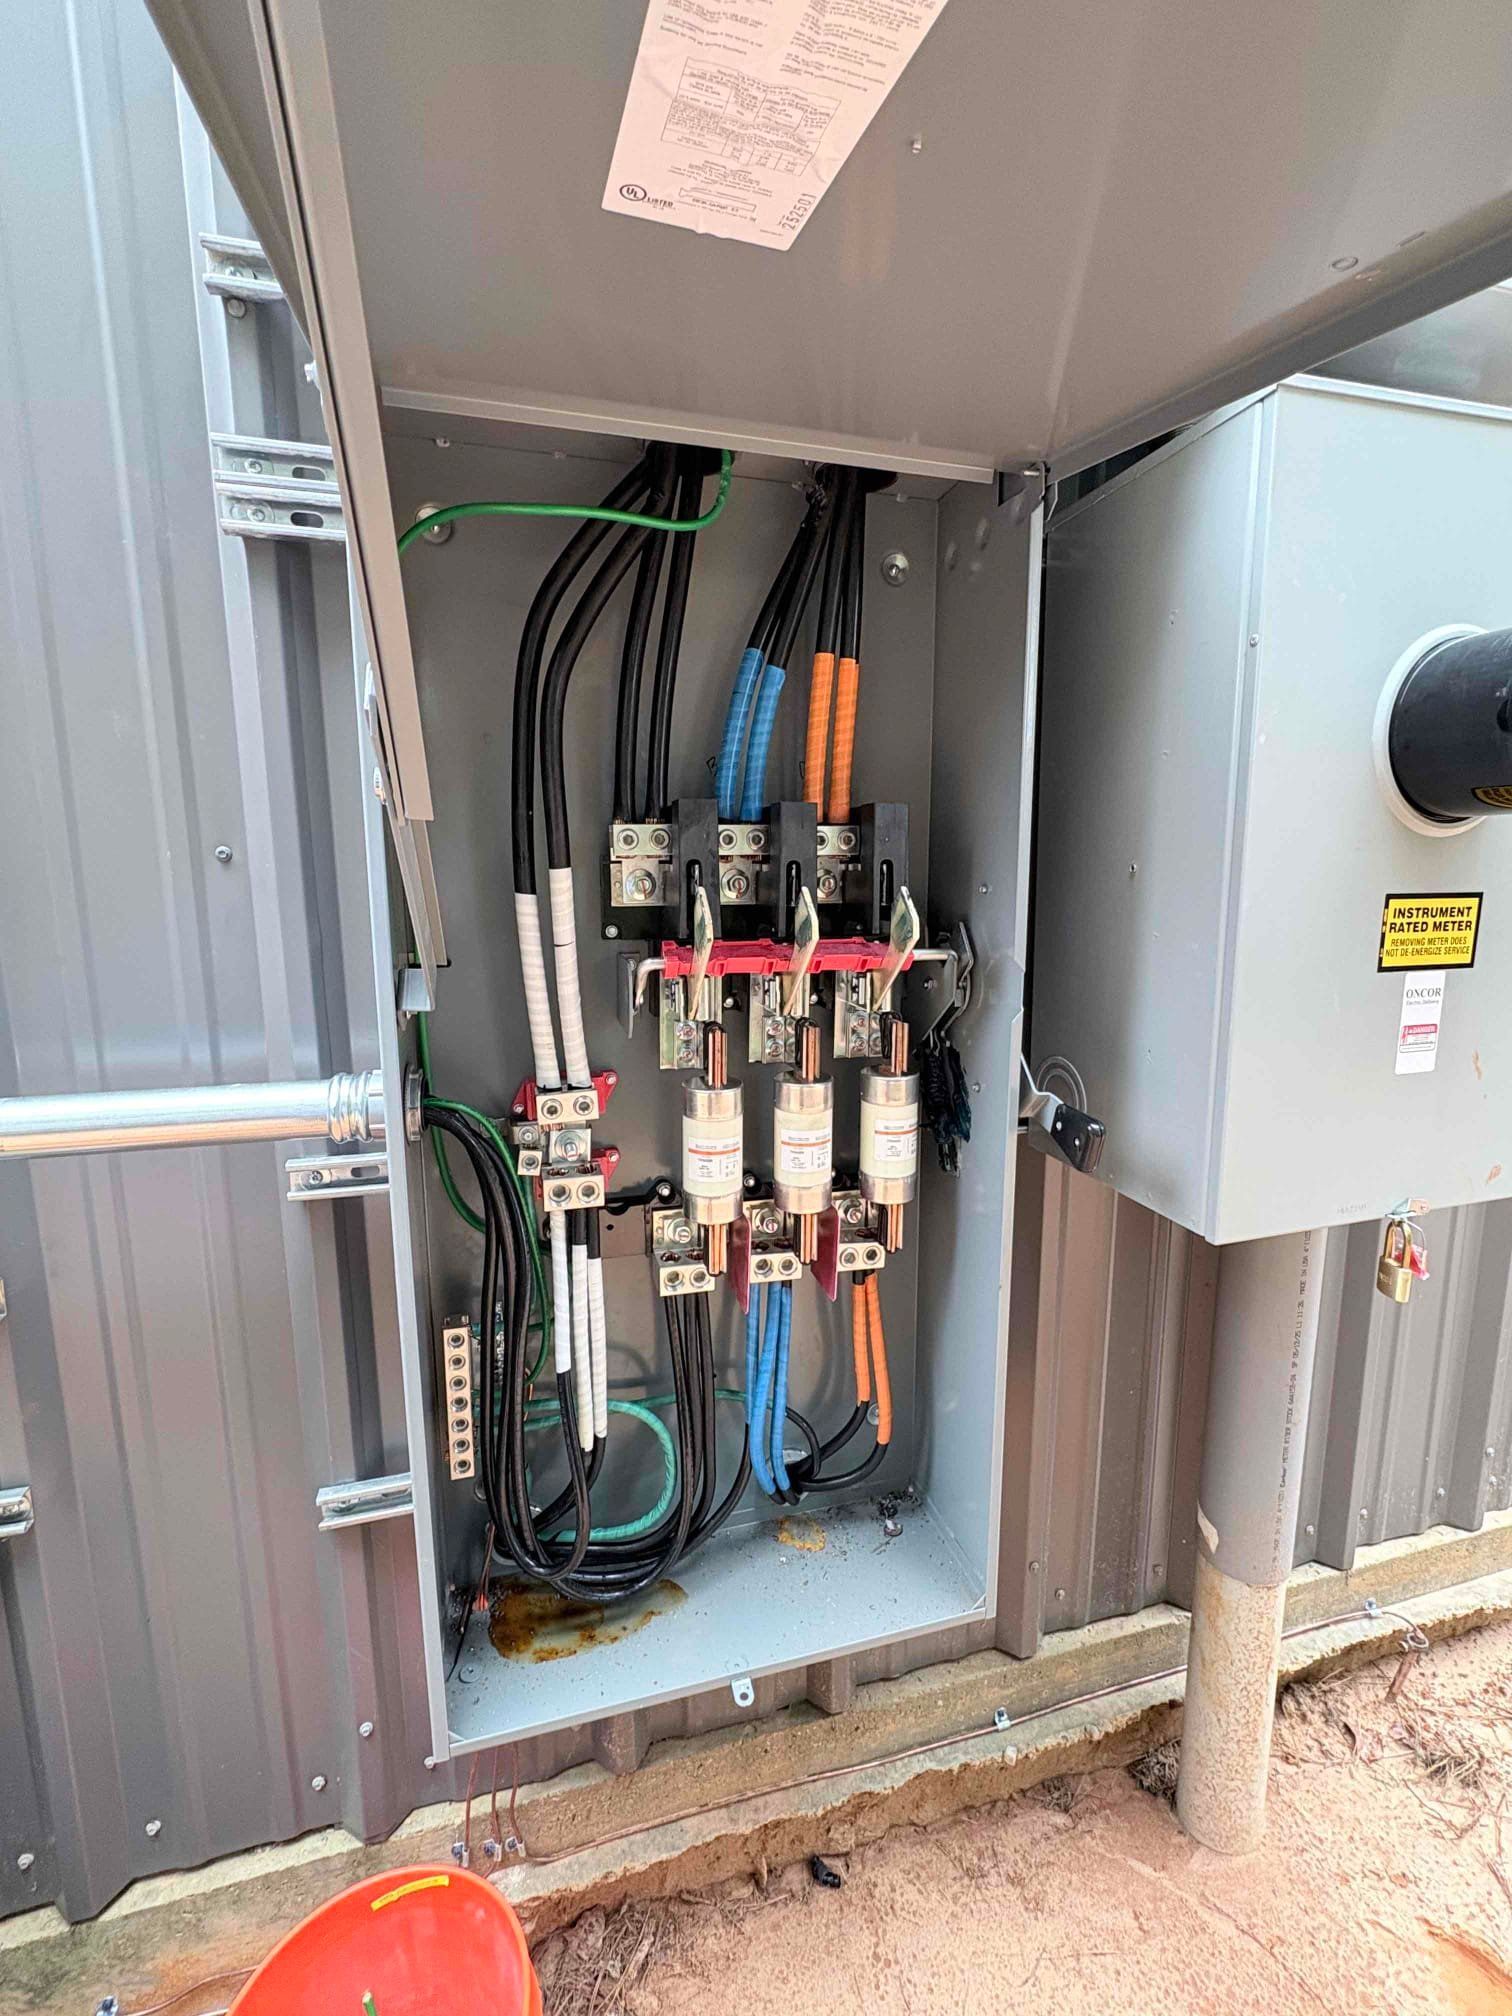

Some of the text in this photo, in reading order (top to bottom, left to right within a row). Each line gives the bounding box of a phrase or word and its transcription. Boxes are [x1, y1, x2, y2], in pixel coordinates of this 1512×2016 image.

[626, 187, 640, 199] UL
[1393, 906, 1472, 919] INSTRUMENT
[1389, 920, 1472, 933] RATED METER
[1391, 936, 1467, 947] REMOVING METER DOES
[1385, 946, 1470, 957] NOT DE-ENERGIZE SERVICE
[1406, 987, 1441, 998] ONCOR
